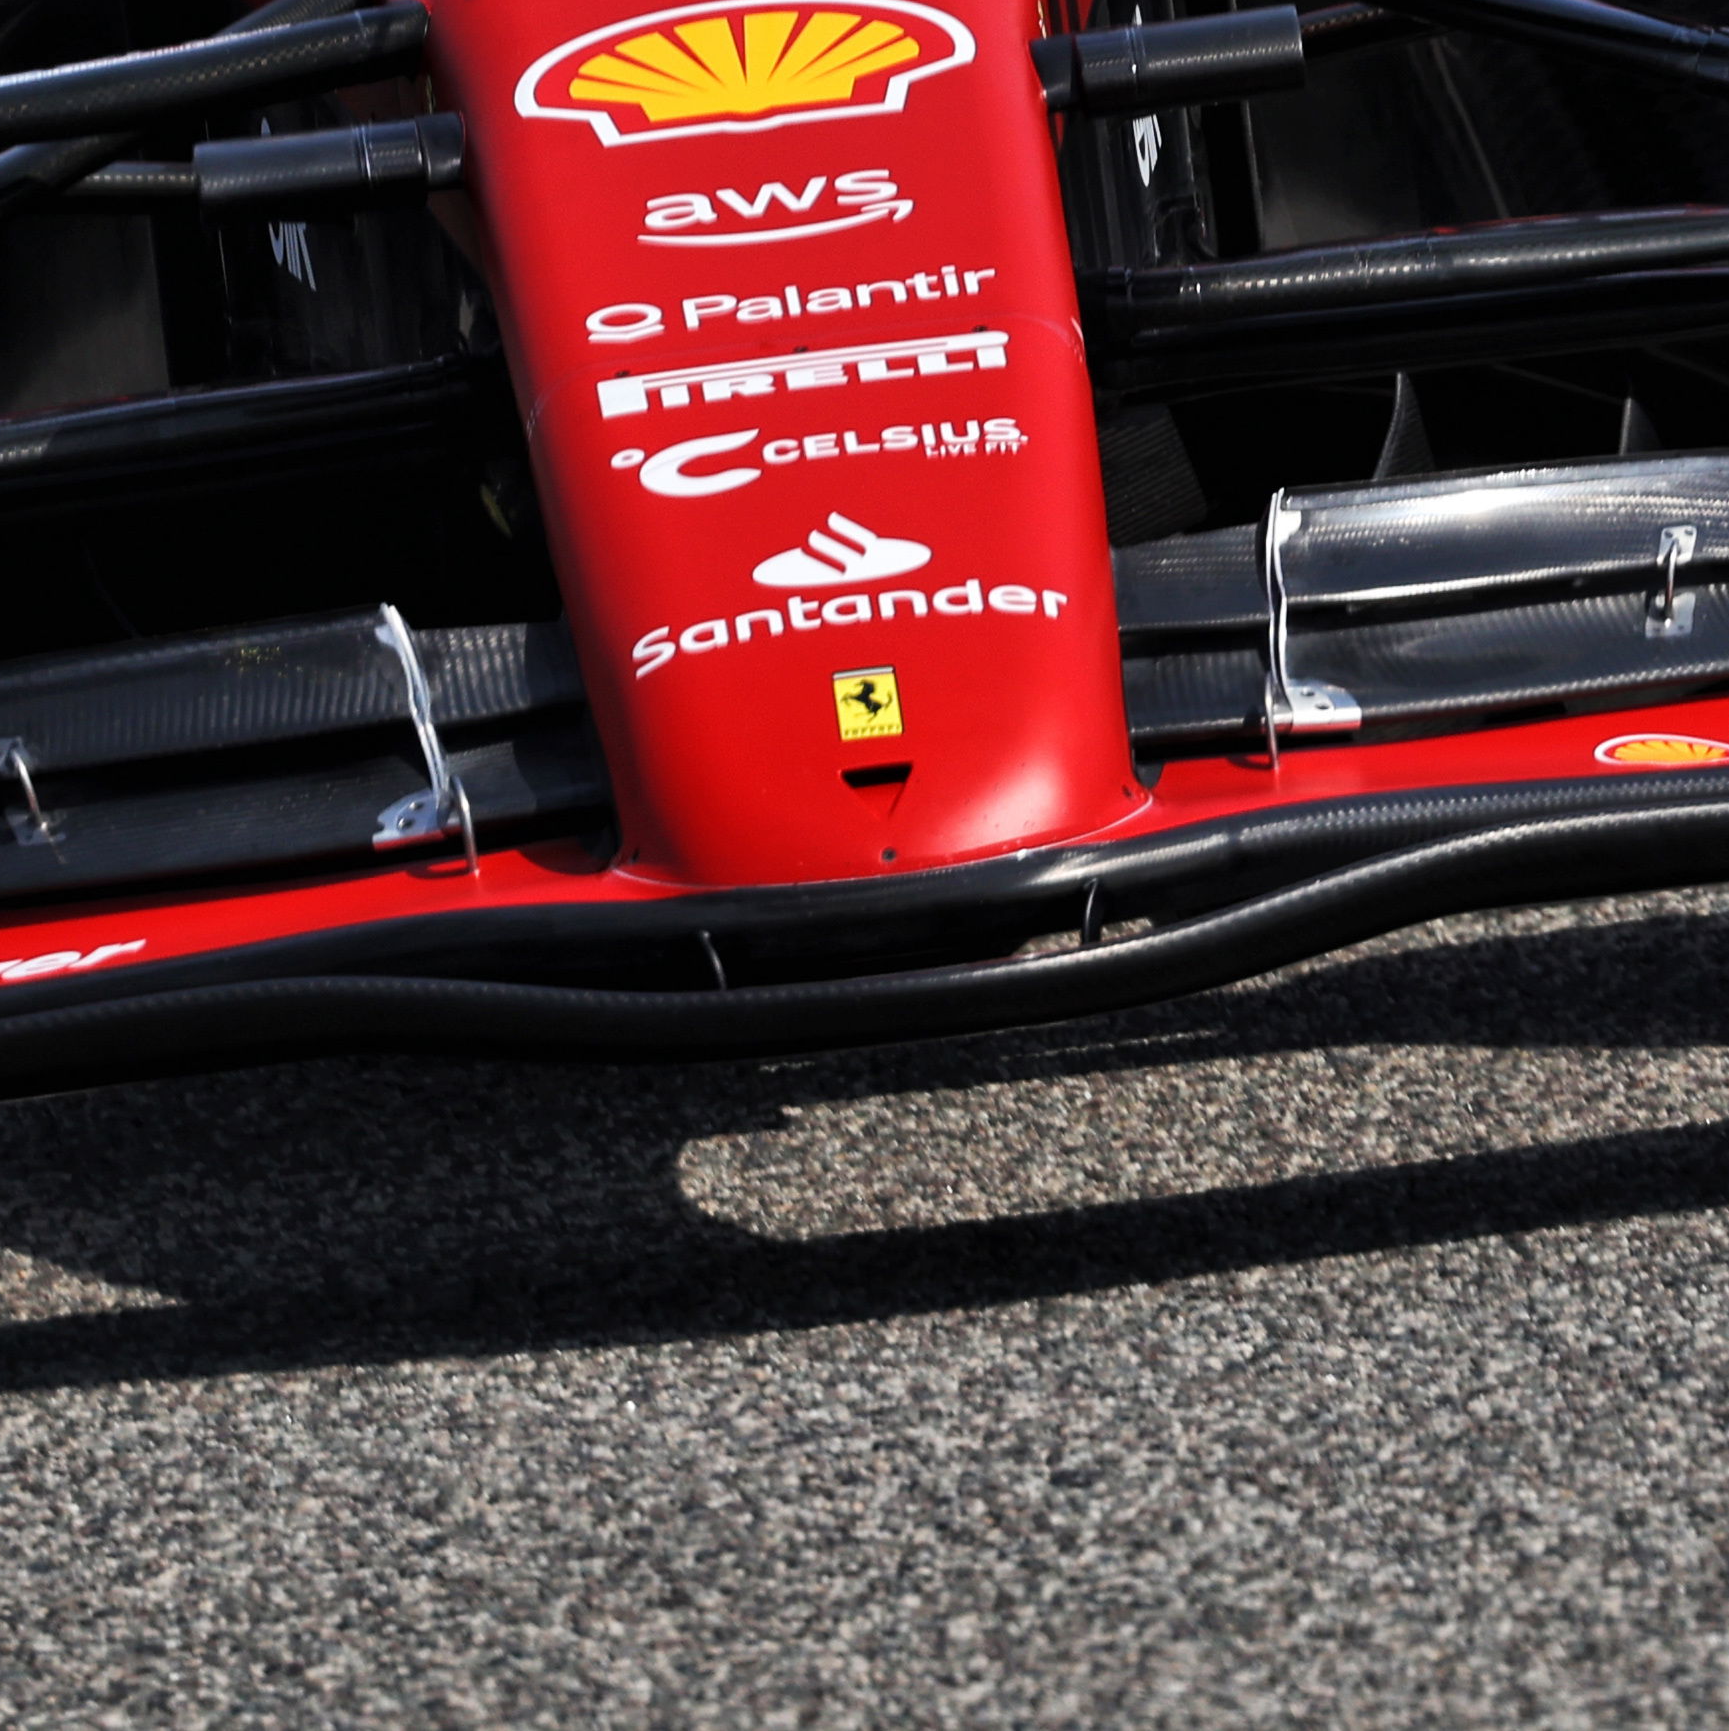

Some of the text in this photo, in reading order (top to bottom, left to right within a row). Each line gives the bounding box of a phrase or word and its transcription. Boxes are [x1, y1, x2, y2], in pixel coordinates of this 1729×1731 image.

[643, 168, 899, 231] aws
[682, 264, 996, 331] Palantir
[596, 329, 1010, 419] PIRELLI
[631, 579, 1068, 681] Santander
